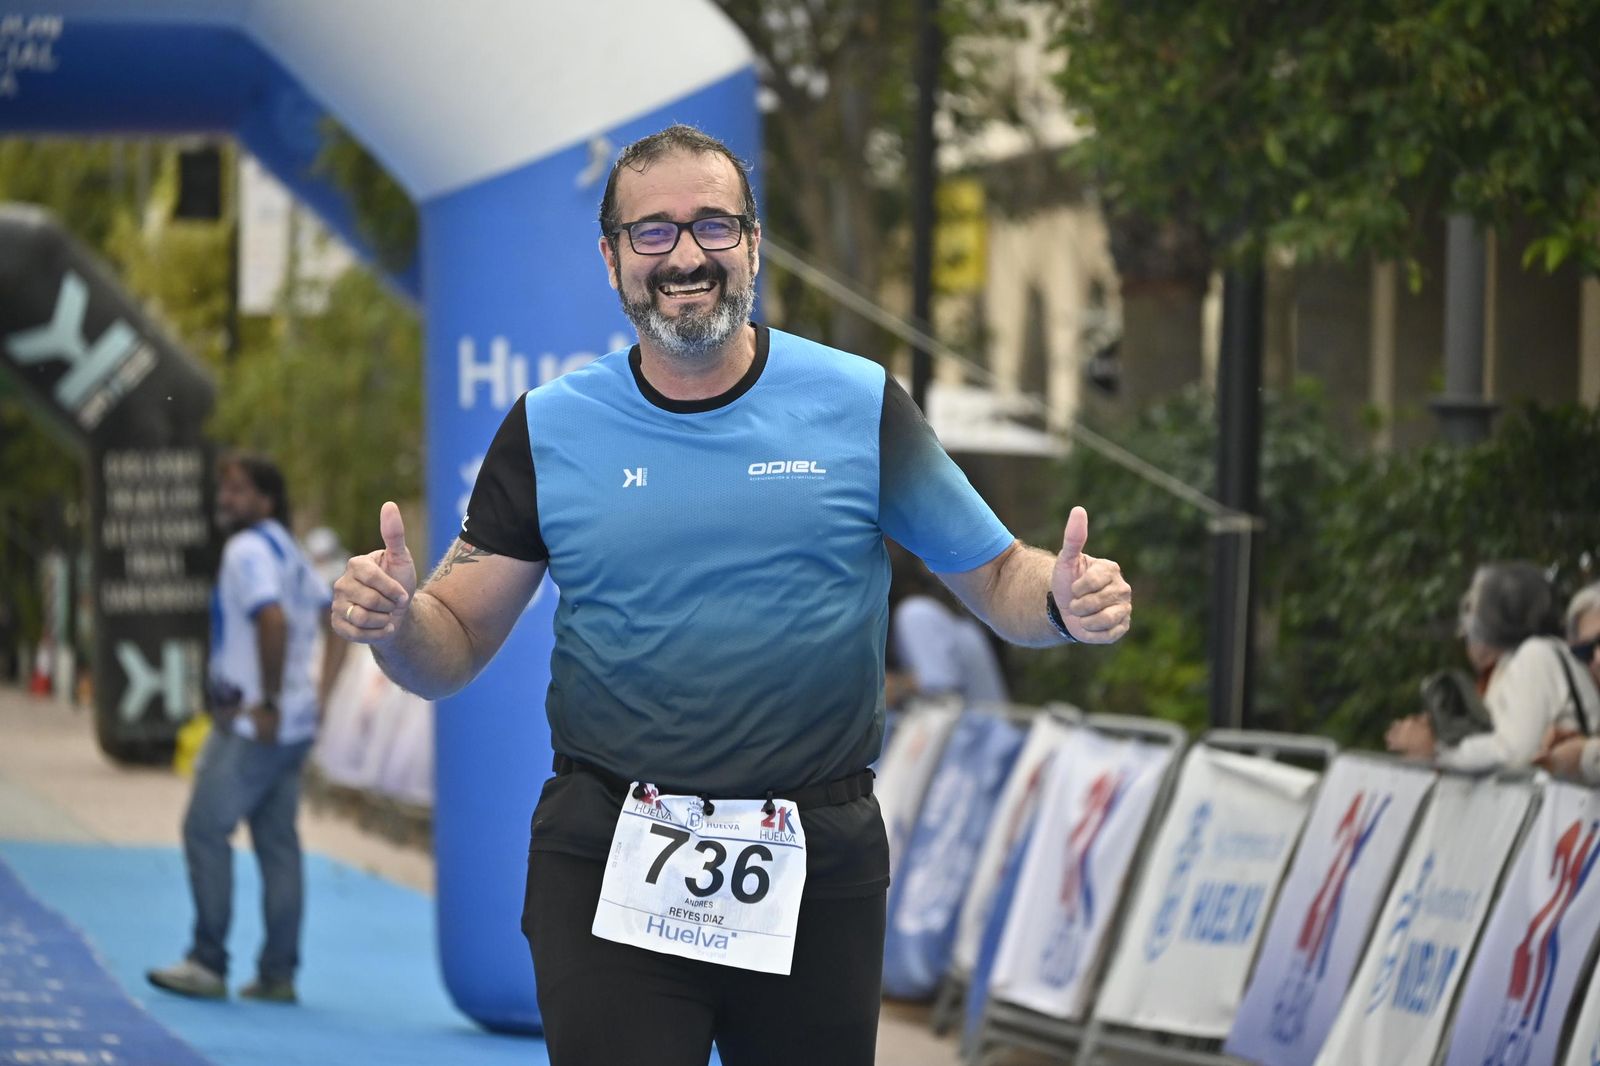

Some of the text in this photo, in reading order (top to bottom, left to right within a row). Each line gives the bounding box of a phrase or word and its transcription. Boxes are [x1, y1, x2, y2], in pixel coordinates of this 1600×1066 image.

[747, 460, 827, 475] ODIEL
[634, 804, 673, 821] HUELVA
[760, 806, 797, 834] 21K
[707, 822, 741, 831] HUELVA
[759, 830, 797, 844] HUELVA
[645, 822, 774, 904] 736
[684, 897, 714, 909] ANDRES
[668, 906, 725, 925] REYES DIAZ
[646, 915, 729, 950] Huelva
